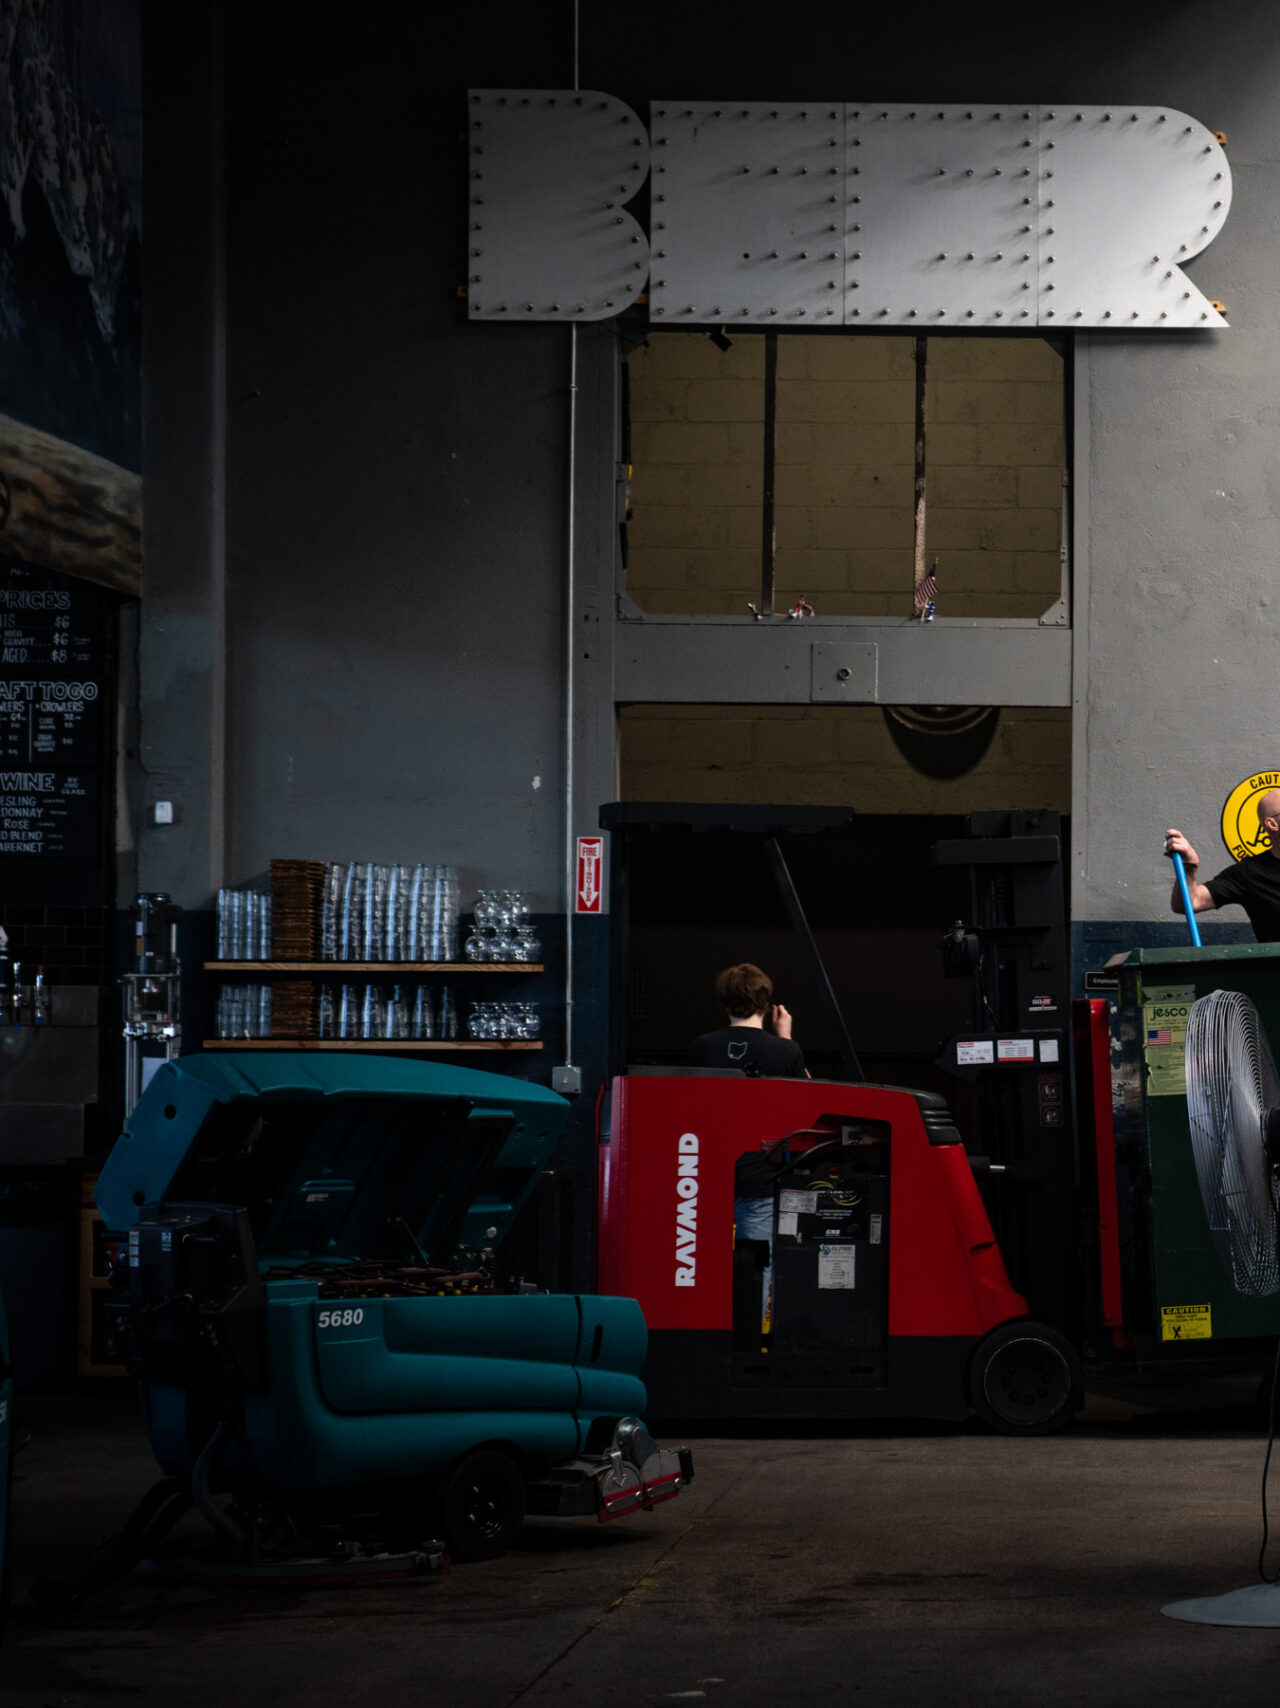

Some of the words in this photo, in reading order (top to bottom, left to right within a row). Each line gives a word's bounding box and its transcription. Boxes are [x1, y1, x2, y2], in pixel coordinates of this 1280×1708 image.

[0, 771, 56, 793] WINE
[10, 831, 43, 842] BLEND
[583, 847, 597, 857] FIRE
[1150, 1006, 1187, 1020] jesco
[674, 1132, 700, 1287] RAYMOND
[318, 1307, 364, 1328] 5680
[1166, 1306, 1207, 1315] CAUTION
